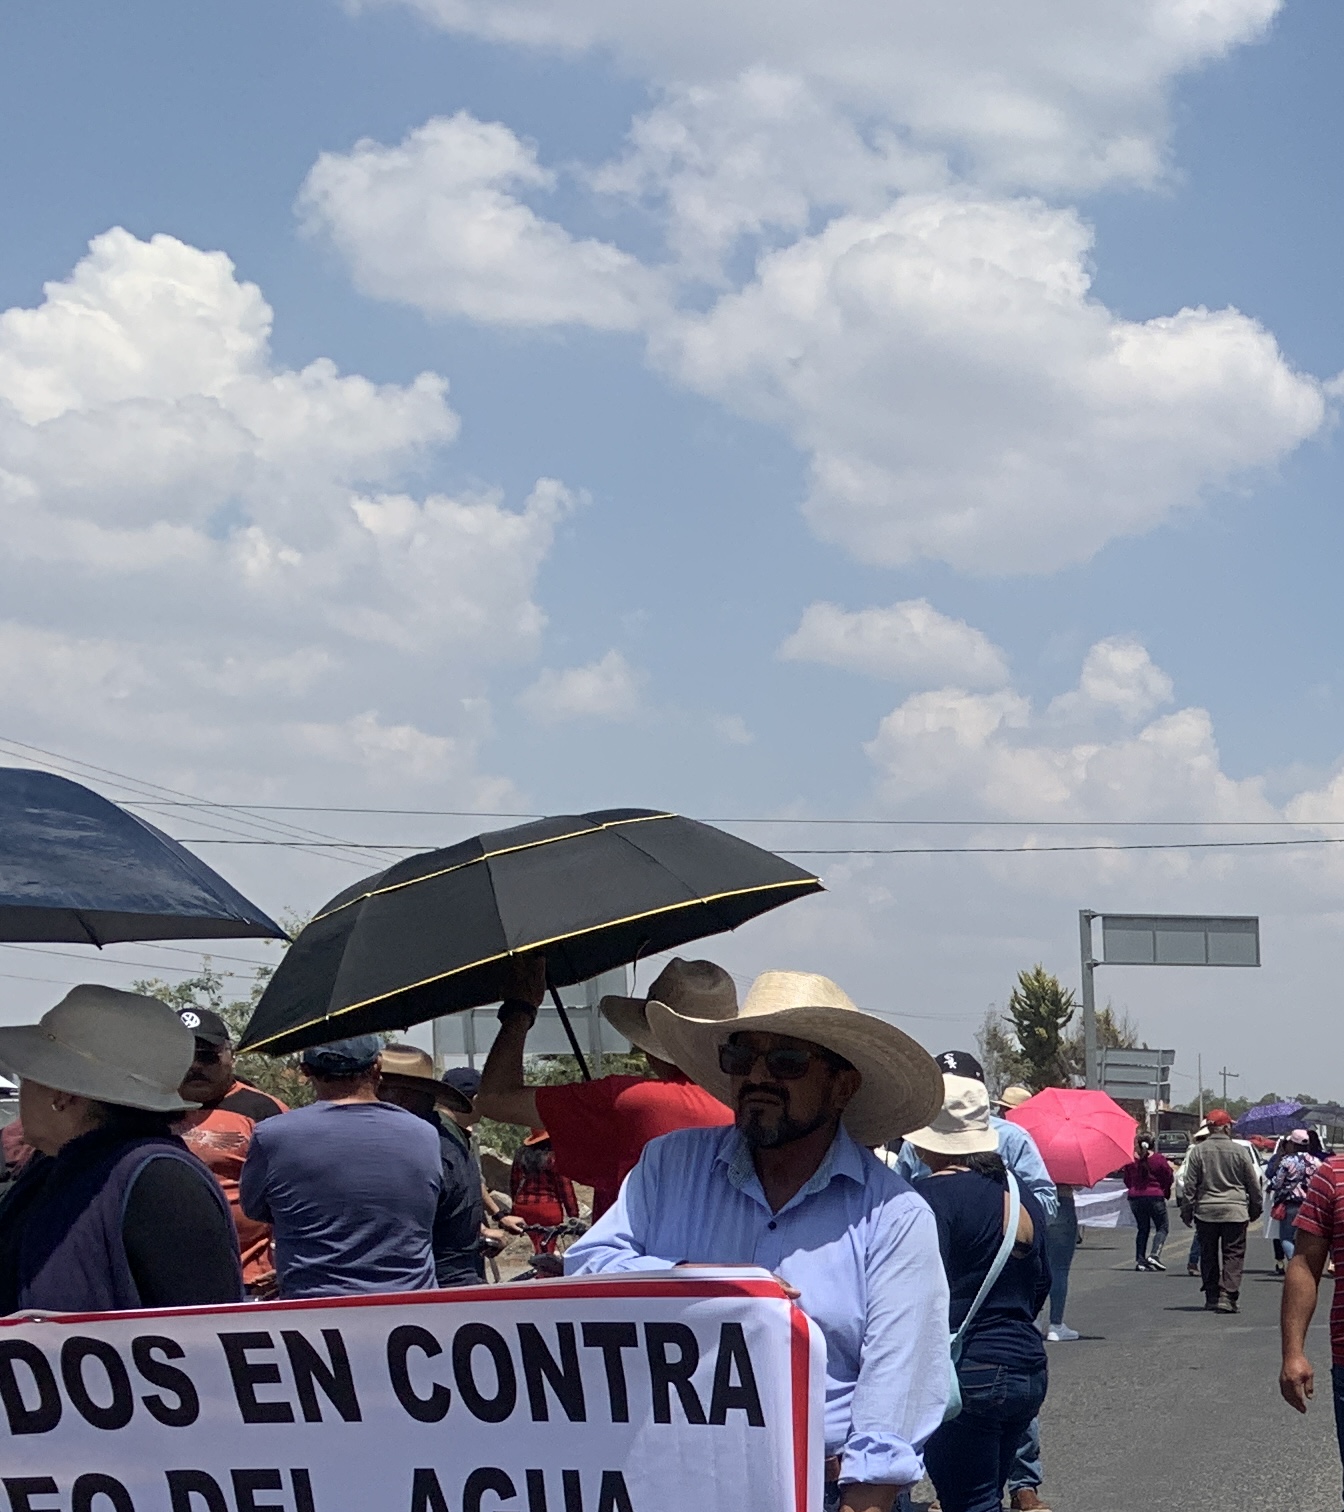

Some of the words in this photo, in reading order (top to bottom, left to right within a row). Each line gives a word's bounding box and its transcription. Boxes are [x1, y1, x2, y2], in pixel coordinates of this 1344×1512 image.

[0, 1336, 199, 1435] DOS
[217, 1328, 362, 1424] EN
[387, 1322, 765, 1427] CONTRA
